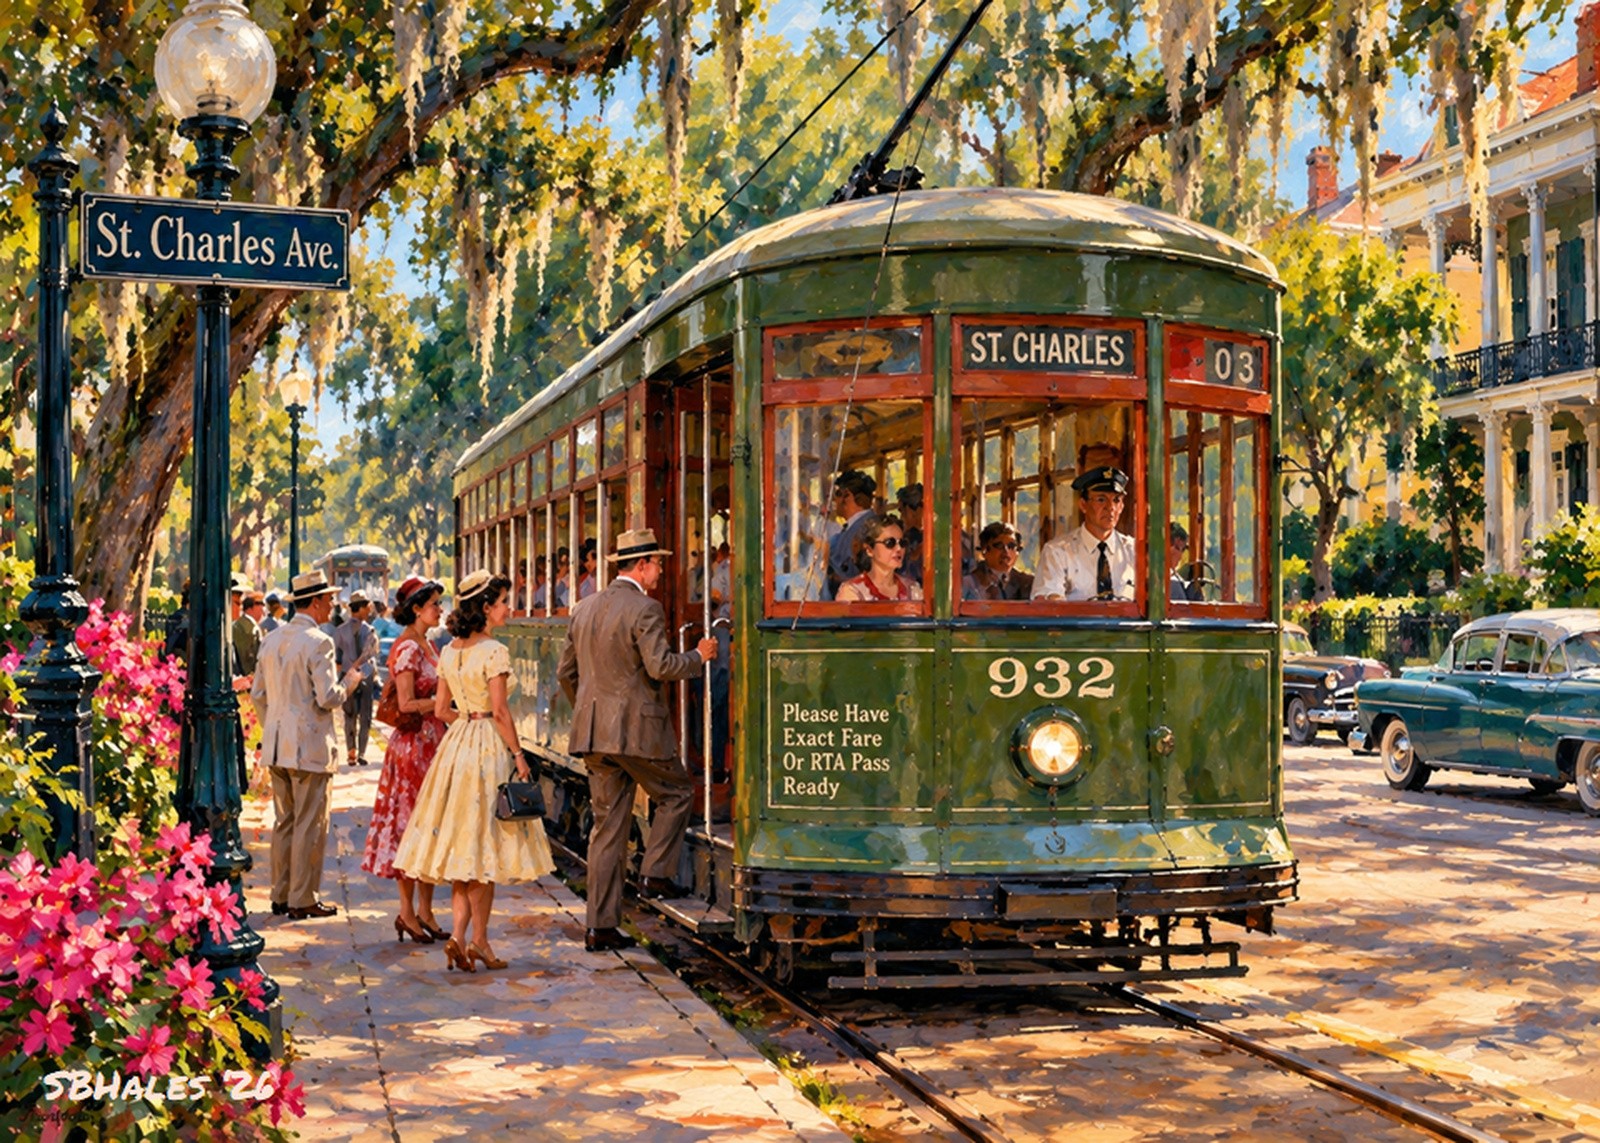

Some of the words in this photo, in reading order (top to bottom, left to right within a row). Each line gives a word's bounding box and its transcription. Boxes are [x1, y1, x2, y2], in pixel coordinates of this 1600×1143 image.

[96, 211, 141, 260] St.
[150, 214, 276, 266] Charles
[283, 227, 339, 270] Ave.
[970, 332, 1006, 363] ST.
[1012, 332, 1126, 367] CHARLES
[987, 657, 1115, 699] 932
[782, 703, 840, 724] Please
[844, 703, 890, 724] Have
[782, 727, 836, 748] Exact
[841, 727, 883, 748] Fare
[782, 752, 806, 772] Or
[810, 752, 846, 772] RTA
[850, 752, 891, 773] Pass
[782, 776, 841, 800] Ready
